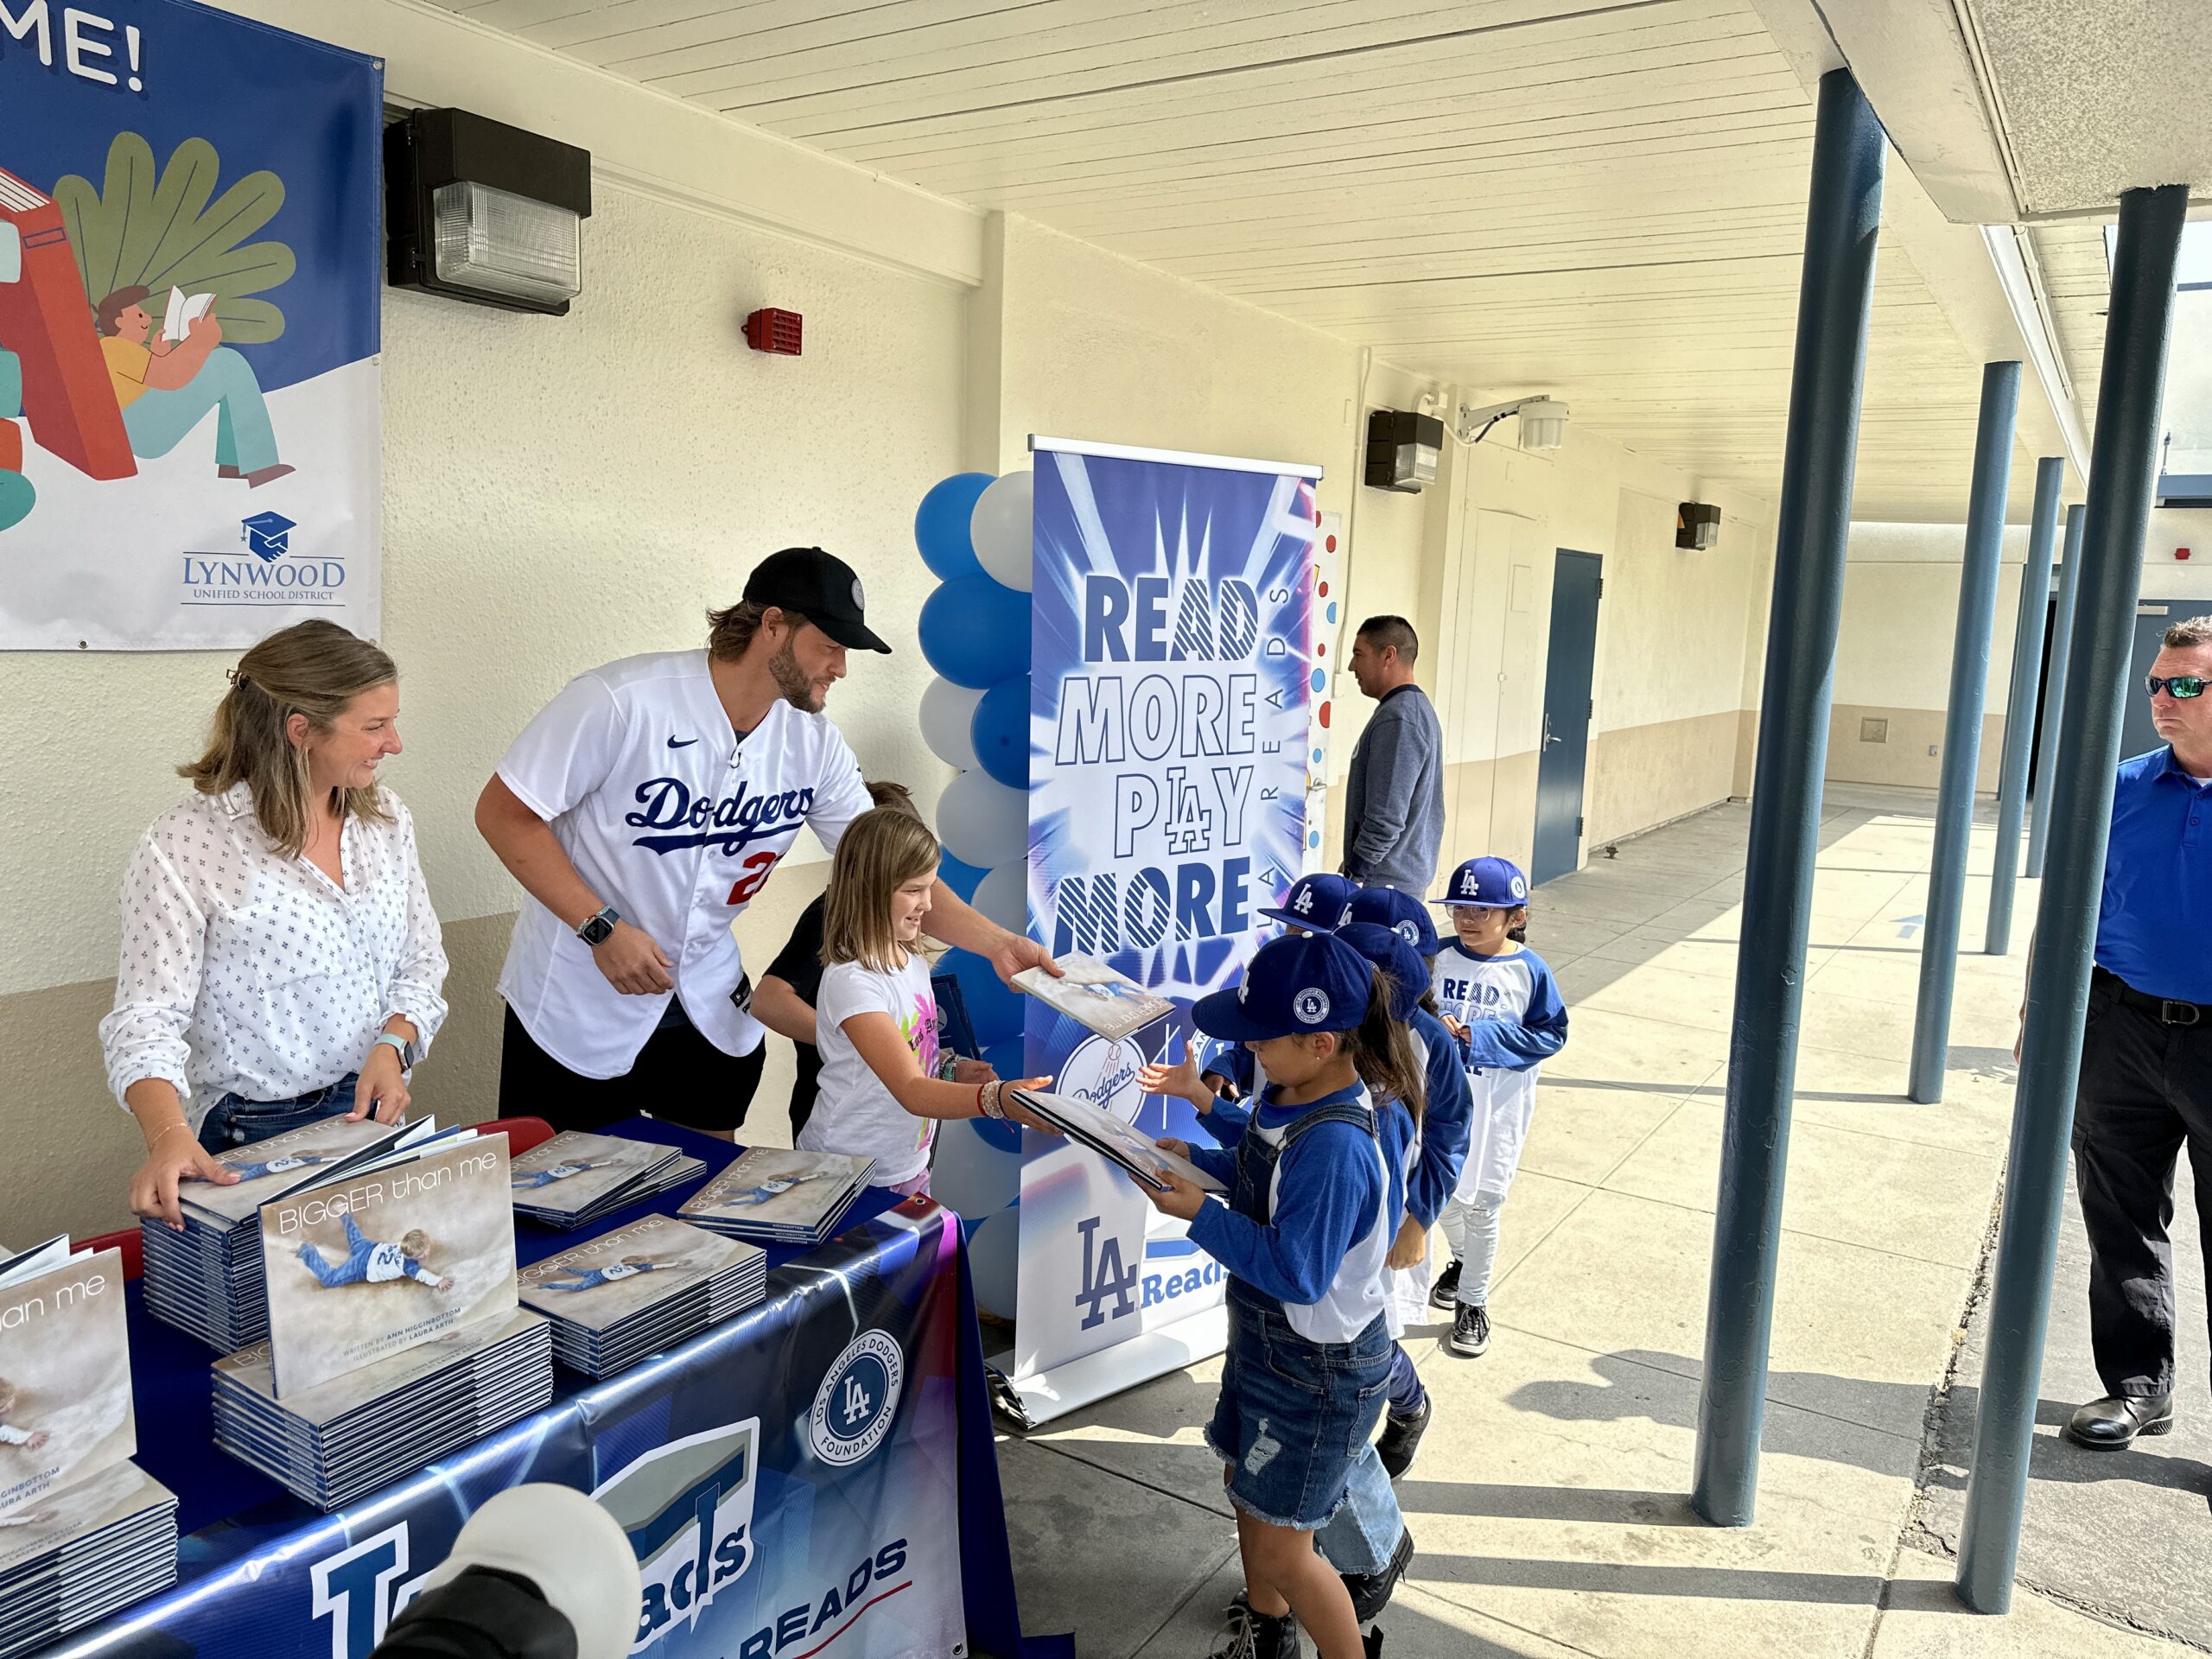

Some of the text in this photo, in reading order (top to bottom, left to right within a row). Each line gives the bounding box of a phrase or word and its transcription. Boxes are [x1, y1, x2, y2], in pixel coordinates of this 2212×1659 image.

[0, 0, 143, 92] ME!
[181, 557, 346, 588] LYNWOOD
[193, 589, 335, 601] UNIFIED SCHOOL DISTRICT
[1084, 575, 1259, 664] READ
[1054, 673, 1258, 767] MORE
[625, 777, 815, 857] Dodgers
[1114, 765, 1255, 860] PLAY
[726, 850, 787, 906] 2
[1293, 882, 1313, 915] LA
[1460, 868, 1479, 896] LA
[1052, 856, 1251, 959] MORE
[1306, 998, 1317, 1013] LA
[1443, 978, 1500, 1007] READ
[257, 1128, 313, 1151] than
[553, 1134, 580, 1147] me
[748, 1148, 769, 1161] me
[279, 1152, 497, 1235] BIGGER than me
[582, 1232, 633, 1255] than
[632, 1218, 664, 1235] me
[1074, 1215, 1229, 1332] LA Read
[0, 1274, 105, 1331] an me
[342, 1306, 461, 1357] WRITTEN BY ANN HIGGINBOTTOM
[353, 1318, 454, 1363] ILLUSTRATED BY LAURA ARTH
[815, 1338, 899, 1426] LOS ANGELES DODGERS
[842, 1375, 871, 1426] LA
[820, 1406, 893, 1457] FOUNDATION
[1387, 1414, 1407, 1428] AUTICA
[24, 1480, 51, 1498] ARTH
